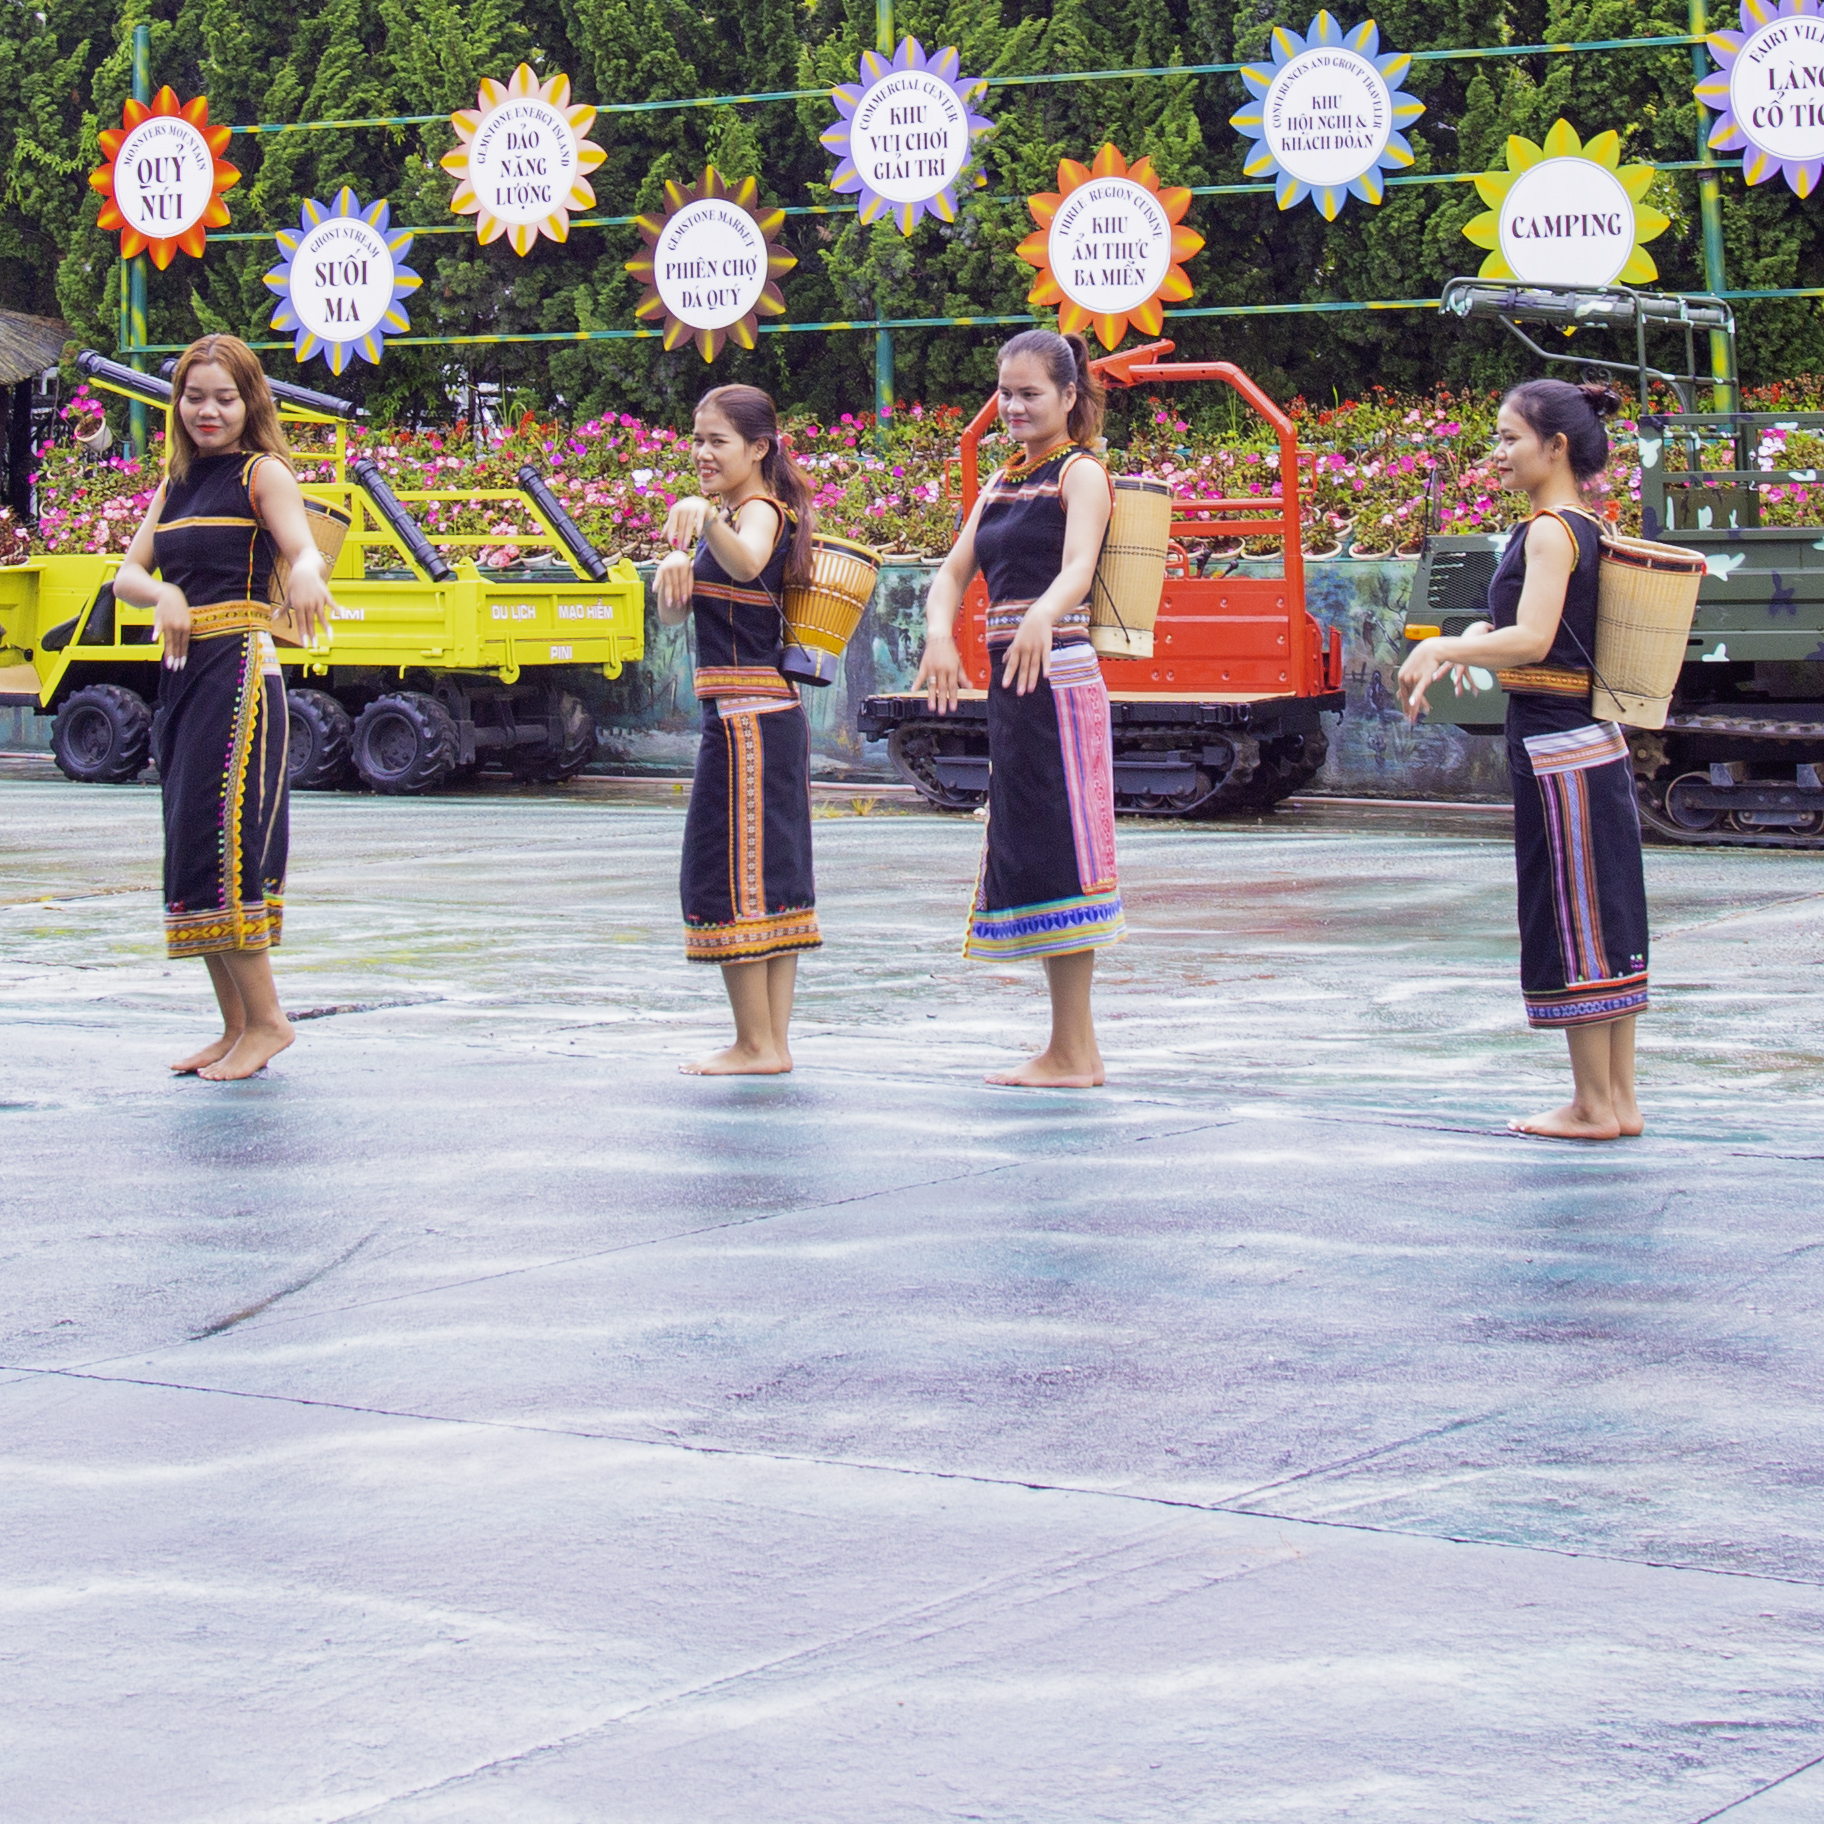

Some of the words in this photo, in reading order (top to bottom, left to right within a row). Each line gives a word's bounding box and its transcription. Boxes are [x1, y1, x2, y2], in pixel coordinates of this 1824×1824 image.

[1749, 28, 1788, 64] FAIRY
[859, 79, 921, 130] COMMERCIAL
[923, 82, 959, 122] CENTER
[1273, 65, 1309, 128] CONFERENCES
[1311, 57, 1330, 69] AND
[1332, 57, 1365, 76] GROUP
[1312, 95, 1342, 109] KHU
[890, 105, 927, 125] KHU
[1753, 91, 1785, 128] CỔ
[478, 110, 514, 164] GEMSTONE
[516, 107, 556, 126] ENERGY
[552, 125, 569, 167] ISLAND
[507, 123, 539, 150] ĐẢO
[1288, 113, 1313, 134] HỘI
[1318, 115, 1352, 133] NGHỊ
[1356, 114, 1367, 128] &
[124, 124, 166, 167] MONSTERS
[168, 125, 207, 171] MOUNTAIN
[870, 134, 900, 152] VUI
[906, 128, 948, 150] CHƠI
[1282, 132, 1330, 151] KHÁCH
[1335, 131, 1373, 149] ĐOÀN
[137, 144, 186, 189] QUỶ
[500, 154, 547, 177] NĂNG
[874, 153, 909, 180] GIẢI
[915, 153, 945, 177] TRÍ
[140, 187, 183, 221] NÚI
[496, 182, 551, 209] LƯỢNG
[1089, 187, 1134, 202] REGION
[1134, 196, 1163, 240] CUISINE
[1092, 217, 1128, 234] KHU
[1511, 213, 1622, 238] CAMPING
[310, 228, 341, 253] GHOST
[343, 228, 380, 258] STREAM
[668, 210, 715, 251] GEMSTONE
[718, 211, 756, 247] MARKET
[1072, 233, 1098, 260] ẨM
[1103, 239, 1149, 264] THỰC
[315, 248, 368, 287] SUỐI
[666, 257, 718, 280] PHIÊN
[723, 255, 758, 281] CHỢ
[1075, 269, 1095, 286] BA
[1101, 260, 1145, 286] MIỀN
[324, 297, 360, 322] MA
[682, 286, 702, 308] ĐÁ
[707, 284, 741, 310] QUÝ
[492, 605, 508, 619] DU
[512, 605, 536, 622] LỊCH
[559, 604, 584, 621] MẠO
[550, 645, 573, 660] PINI
